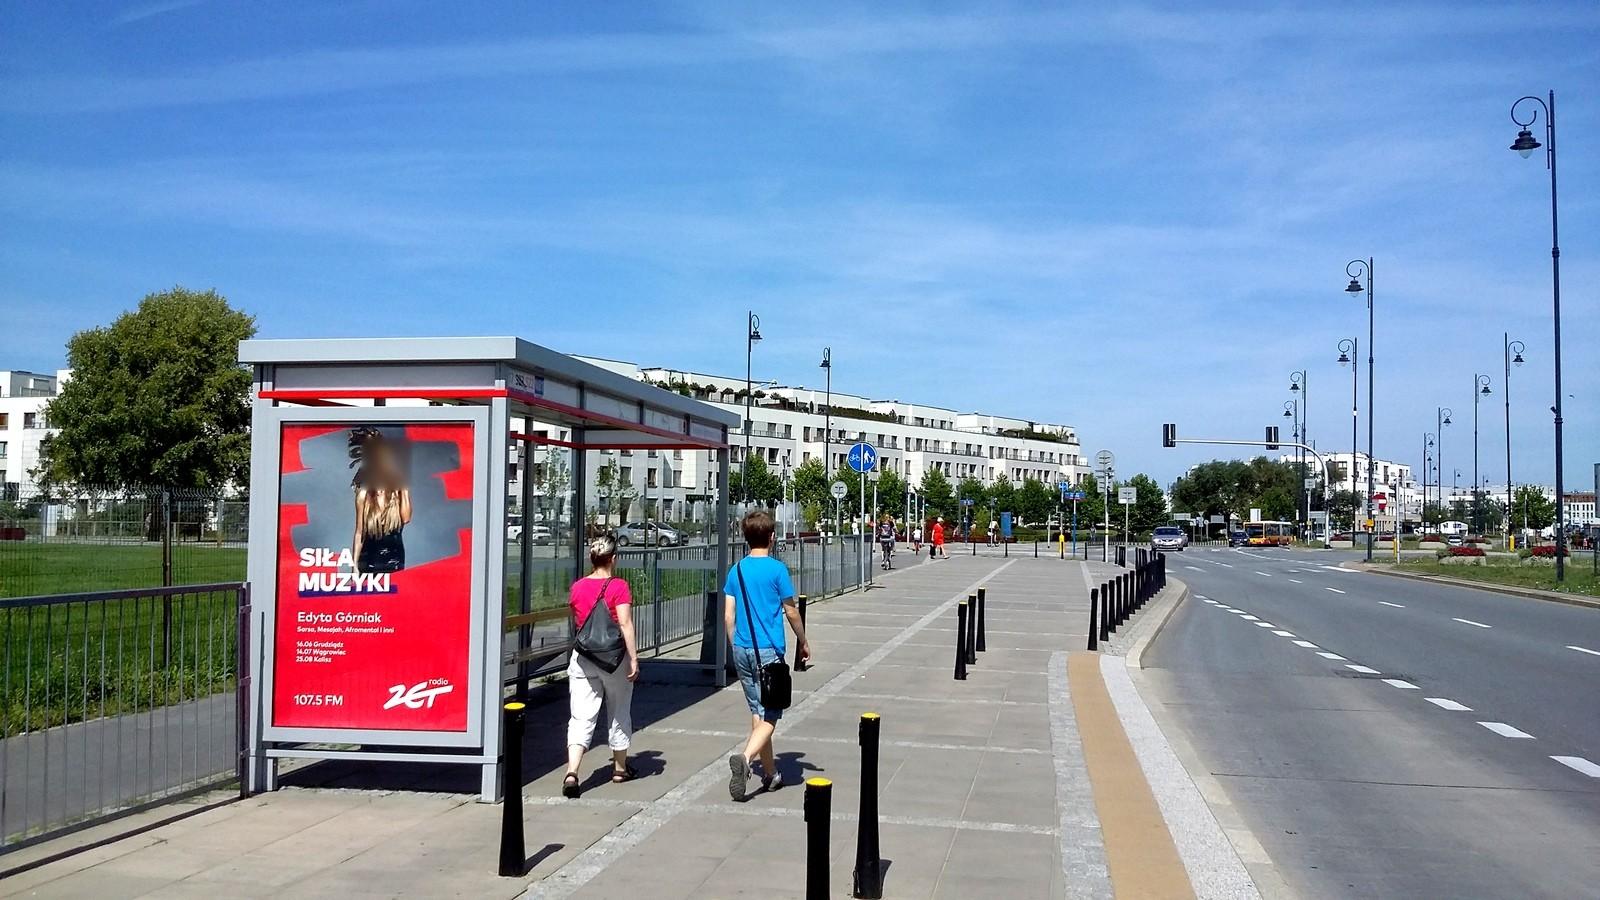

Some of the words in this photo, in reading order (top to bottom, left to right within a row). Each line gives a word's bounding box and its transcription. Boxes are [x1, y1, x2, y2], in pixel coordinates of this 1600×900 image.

[299, 547, 355, 567] SIŁA
[298, 572, 391, 592] MUZYKI
[297, 612, 333, 624] Edyta
[335, 612, 382, 623] Górniak
[294, 695, 322, 706] 107.5
[325, 695, 343, 706] FM
[383, 682, 454, 710] ZET
